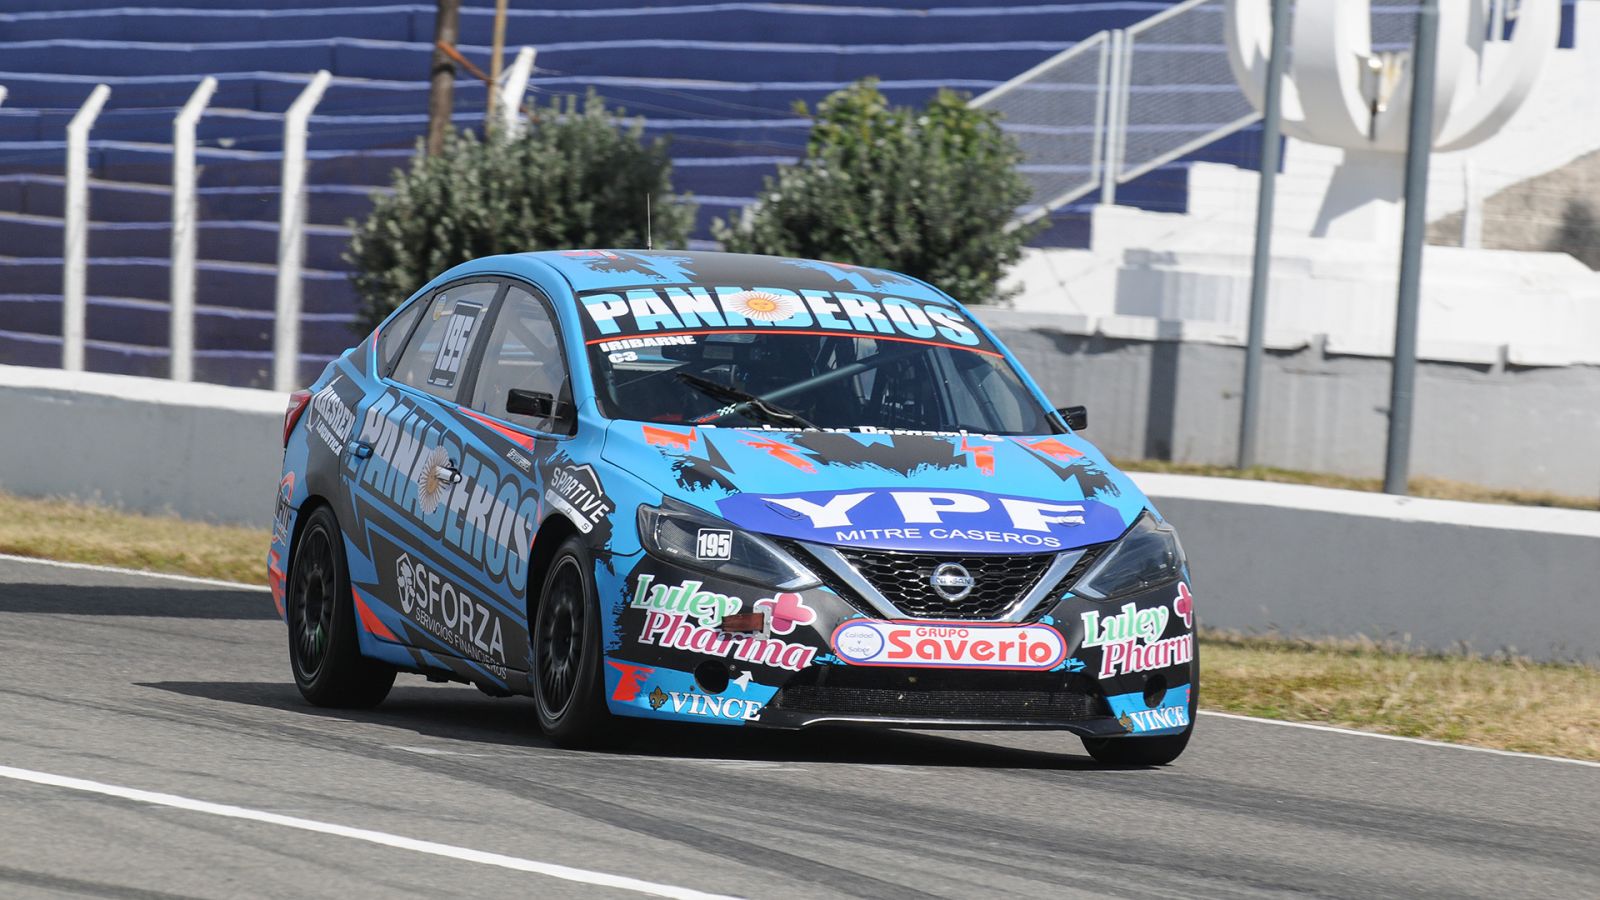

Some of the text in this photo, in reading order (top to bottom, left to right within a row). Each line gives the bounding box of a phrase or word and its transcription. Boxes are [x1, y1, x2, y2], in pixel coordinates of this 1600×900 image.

[435, 314, 474, 373] 195
[599, 335, 697, 352] IRIBARNE
[608, 351, 638, 364] C3
[551, 467, 610, 524] SPORTIVE
[760, 492, 1085, 533] YPF
[699, 533, 730, 557] 195
[835, 528, 1061, 548] MITRE CASEROS
[415, 563, 506, 665] SFORZA
[631, 574, 742, 627] Luley
[416, 607, 507, 680] SERVICIOS FINANCIEROS
[639, 611, 817, 671] Pharma
[916, 627, 968, 638] GRUPO
[1081, 602, 1169, 648] Luley
[887, 630, 1053, 663] Saverio
[1098, 634, 1193, 680] Pharm
[669, 691, 764, 722] VINCE
[1130, 706, 1188, 732] VINCE
